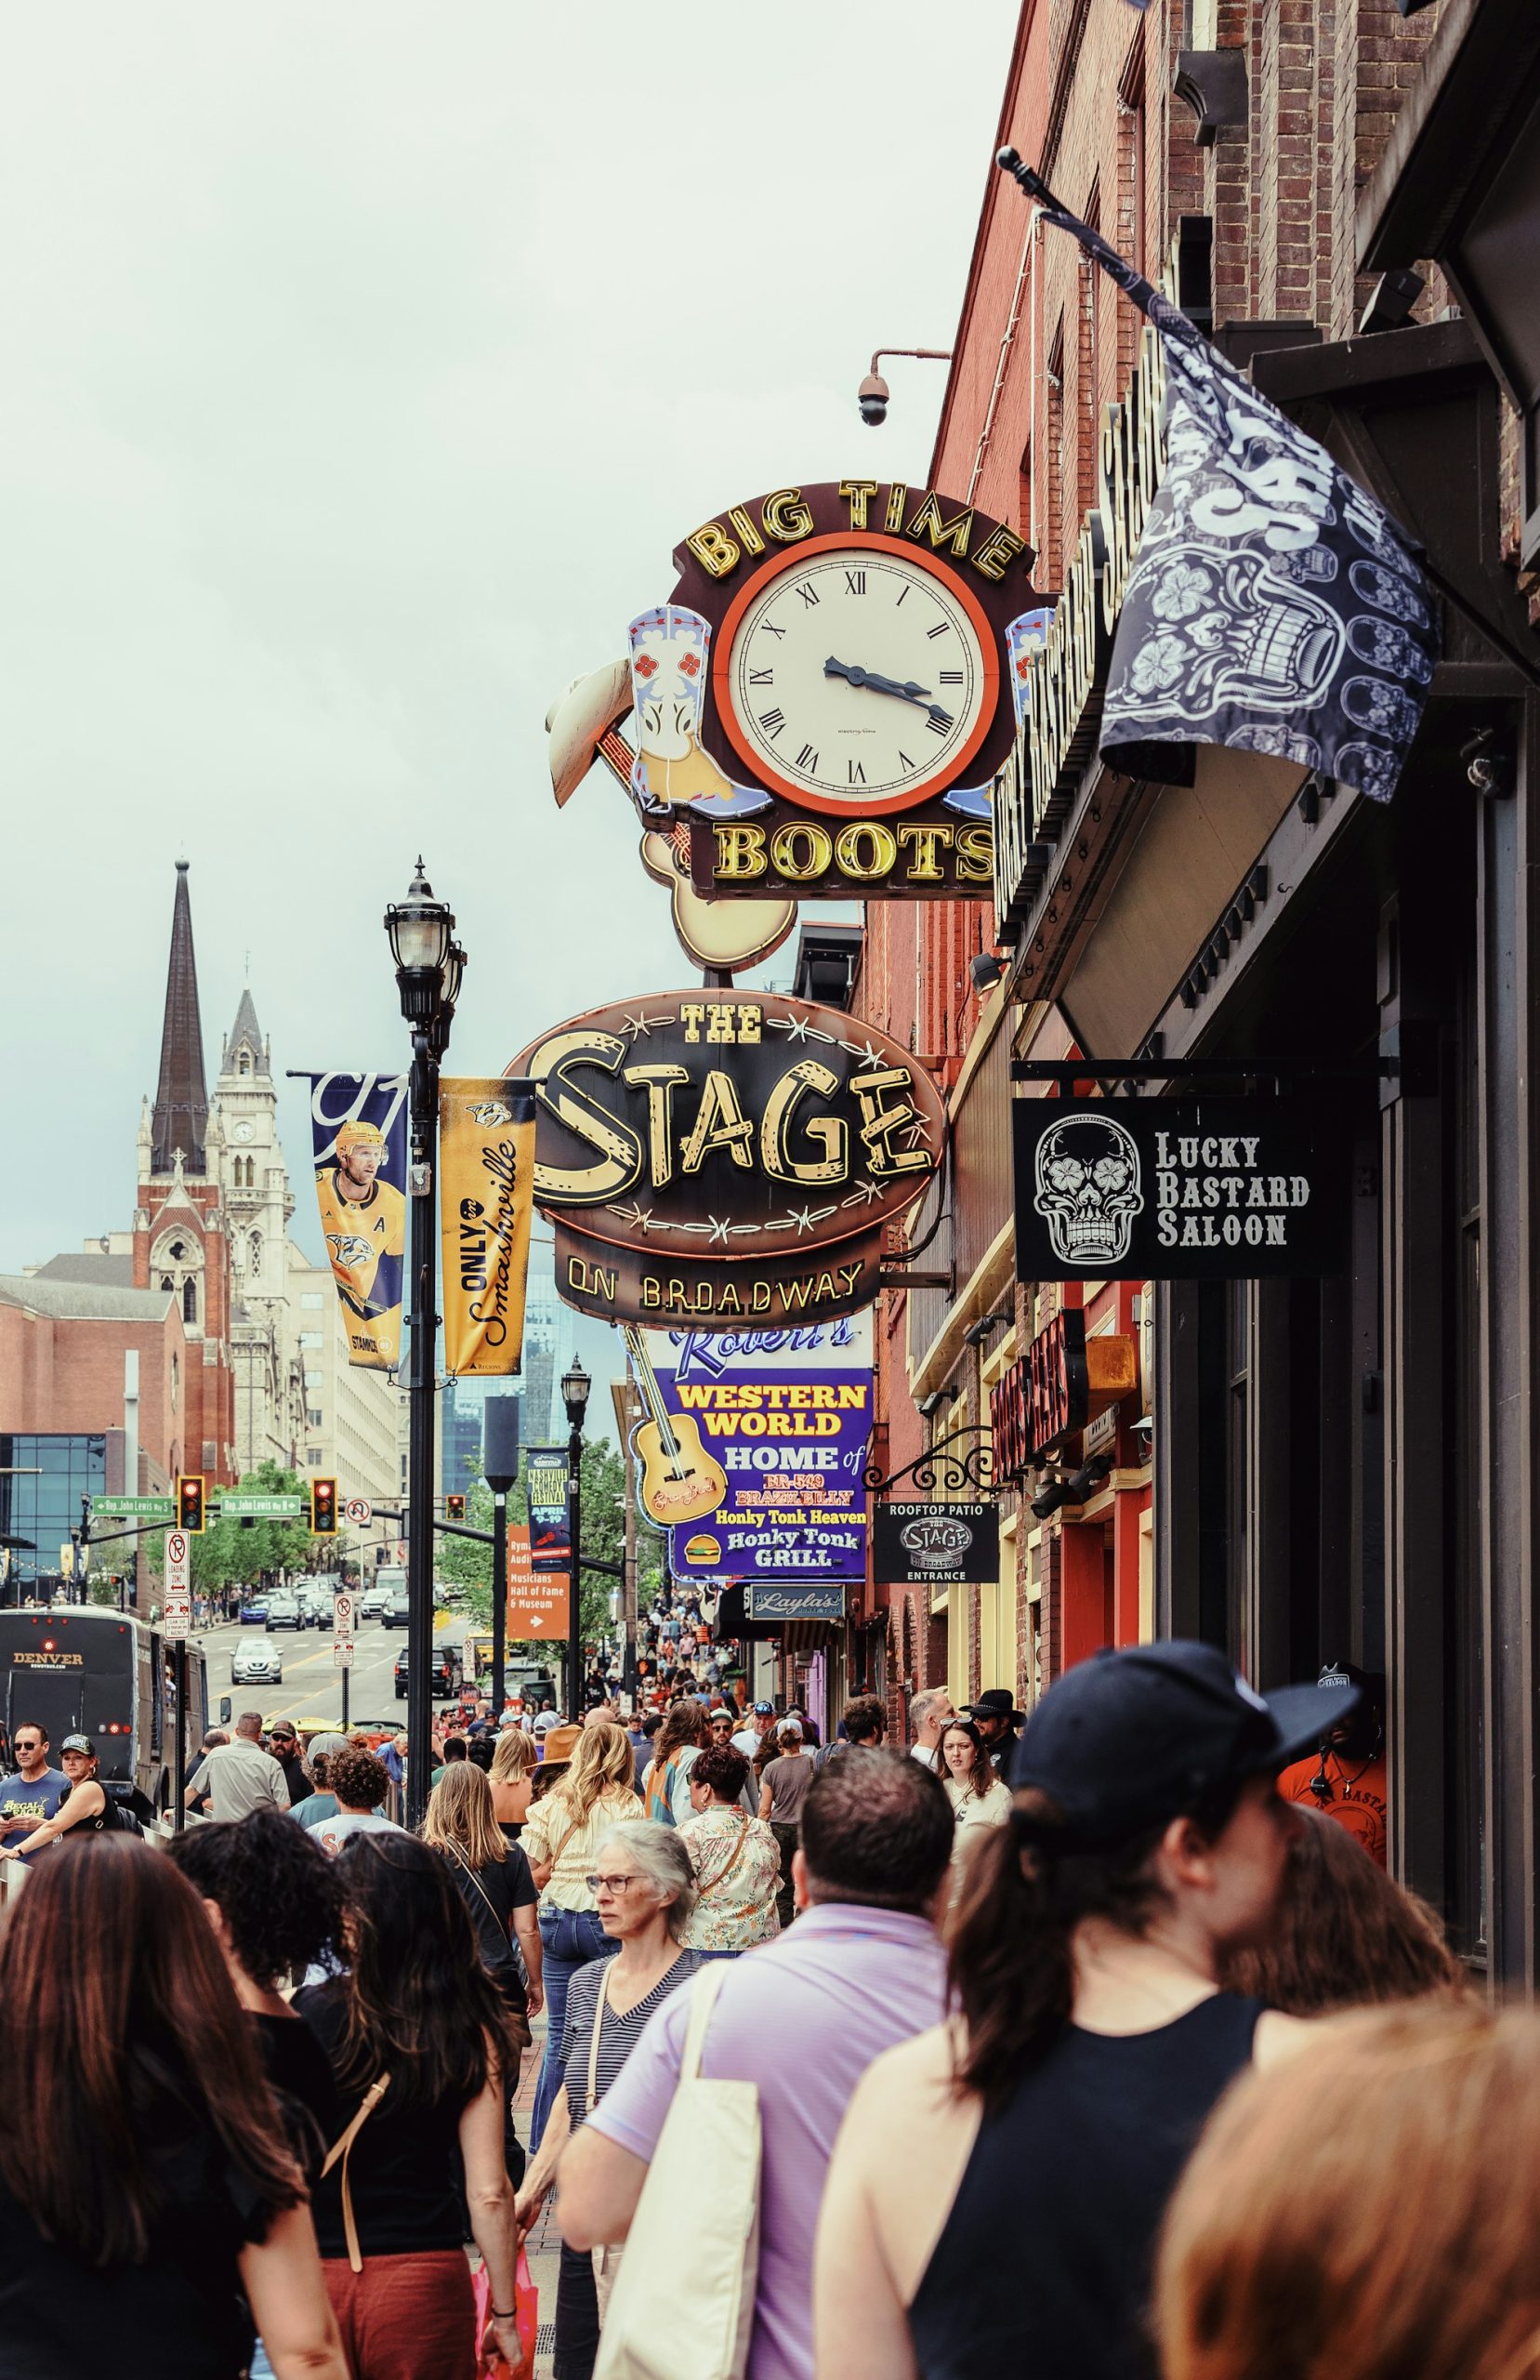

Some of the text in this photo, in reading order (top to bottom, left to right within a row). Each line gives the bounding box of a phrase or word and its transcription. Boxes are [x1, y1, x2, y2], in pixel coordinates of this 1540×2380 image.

[685, 479, 1027, 581] BIG TIME
[845, 571, 866, 595] XII
[795, 582, 820, 609] XI
[895, 586, 911, 606] I
[761, 618, 786, 640] X
[926, 621, 951, 640] II
[749, 668, 773, 685] IX
[940, 670, 963, 684] III
[796, 744, 820, 774] VII
[899, 750, 915, 773] V
[849, 760, 866, 783] VI
[712, 822, 994, 880] BOOTS
[680, 1003, 762, 1043] THE
[533, 1030, 934, 1204] STAGE
[1155, 1131, 1259, 1169] LUCKY
[1156, 1170, 1310, 1209] BASTARD
[1157, 1209, 1287, 1247] SALOON
[468, 1139, 516, 1347] Smashville
[460, 1223, 487, 1291] ONLY
[567, 1257, 865, 1315] ON BROADWAY
[677, 1384, 867, 1409] WESTERN
[703, 1411, 843, 1436] WORLD
[724, 1445, 866, 1475] HOME of
[529, 1469, 567, 1482] NASHVILLE
[763, 1474, 825, 1490] BR-549
[533, 1482, 562, 1492] COMEDY
[533, 1492, 565, 1503] FESTIVAL
[735, 1490, 854, 1506] BRAZIL BILLY
[119, 1501, 134, 1512] John
[134, 1501, 153, 1512] Lewis
[164, 1502, 168, 1513] S
[237, 1500, 253, 1511] John
[253, 1500, 271, 1511] Lewis
[531, 1506, 567, 1515] APRIL
[889, 1505, 983, 1515] ROOFTOP PATIO
[536, 1515, 562, 1524] 9-19
[715, 1509, 867, 1528] Honky Tonk Heaven
[727, 1527, 860, 1550] Honky Tonk
[905, 1523, 968, 1550] STAGE
[755, 1549, 833, 1568] GRILL
[511, 1573, 552, 1583] Musicians
[907, 1572, 966, 1580] ENTRANCE
[511, 1586, 564, 1596] Hall of Fame
[510, 1599, 553, 1608] & Museum
[755, 1593, 839, 1615] Layla's
[13, 1652, 84, 1665] DENVER
